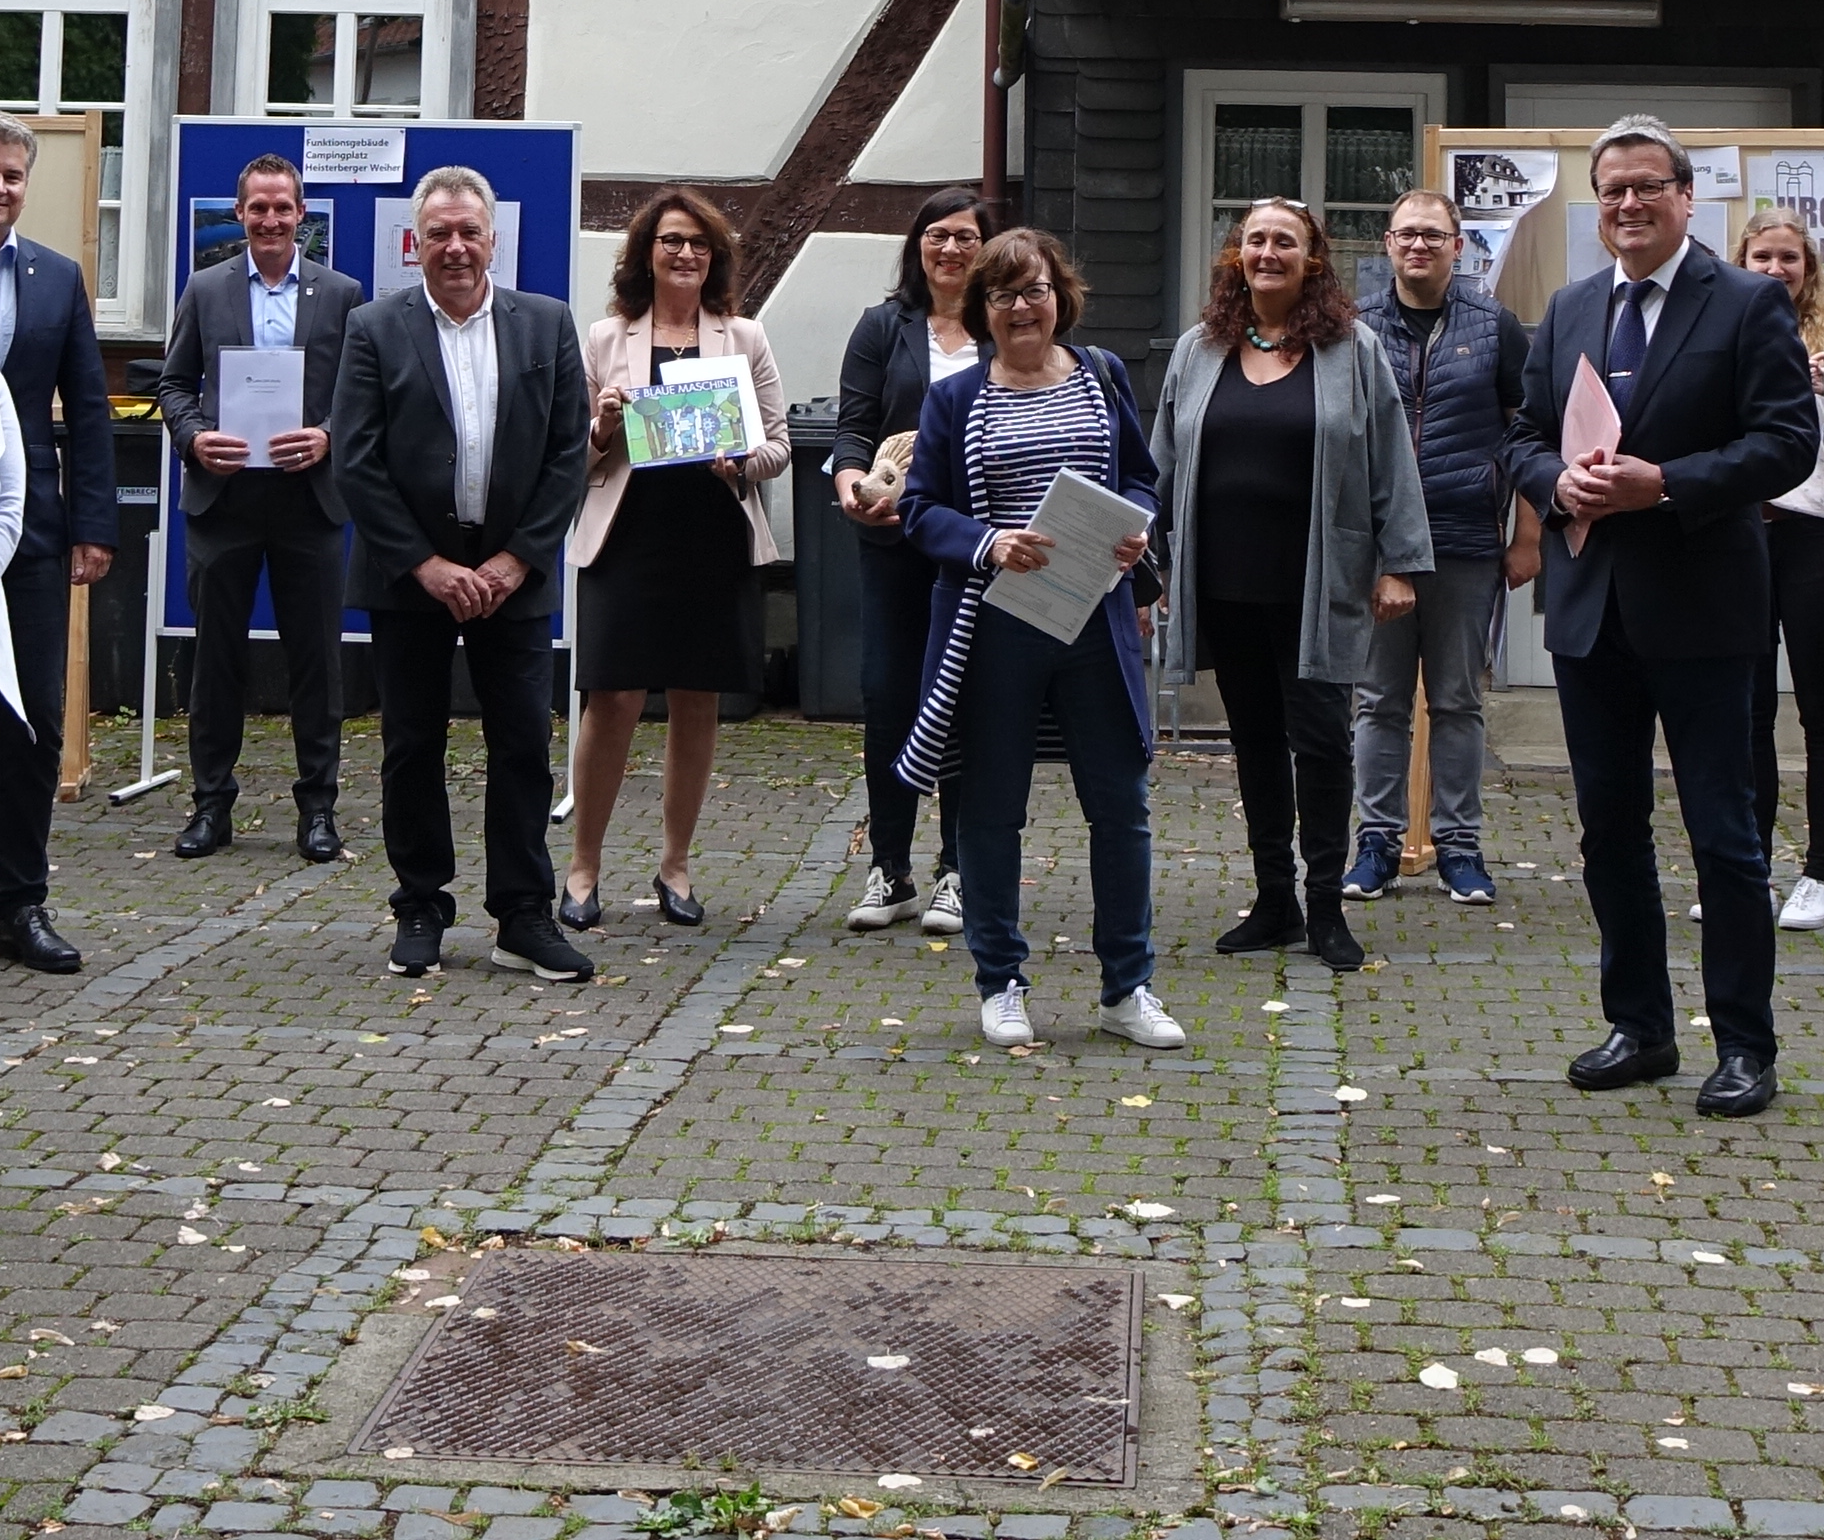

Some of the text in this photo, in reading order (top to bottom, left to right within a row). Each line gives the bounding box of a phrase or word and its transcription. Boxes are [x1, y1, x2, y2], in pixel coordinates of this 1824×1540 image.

[306, 138, 389, 148] Funktionsgebäude
[305, 150, 368, 161] Campingplatz
[305, 163, 401, 173] Heisterberger Weiher
[643, 385, 676, 398] BLAUE
[677, 378, 736, 393] MASCHINE
